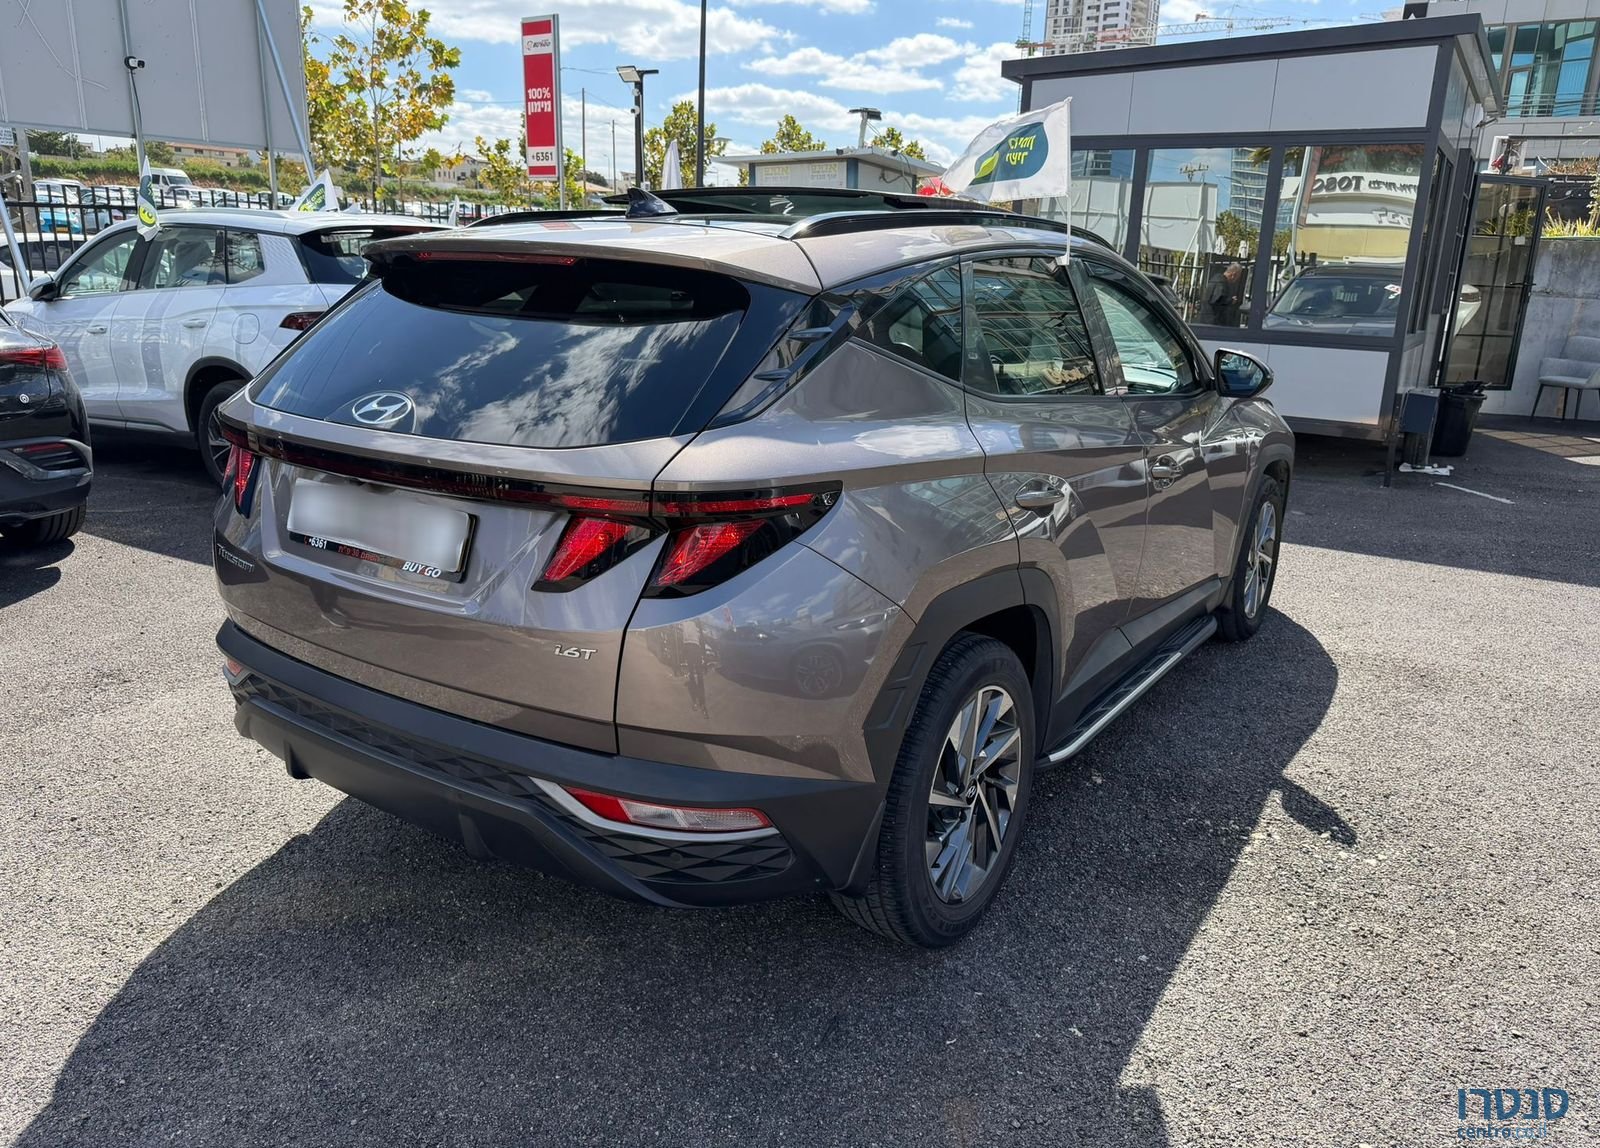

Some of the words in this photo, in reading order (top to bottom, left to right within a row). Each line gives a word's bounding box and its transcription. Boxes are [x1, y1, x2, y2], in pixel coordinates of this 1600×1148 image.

[528, 87, 551, 99] 100%
[528, 100, 552, 115] מימון
[554, 644, 597, 660] 1.6T
